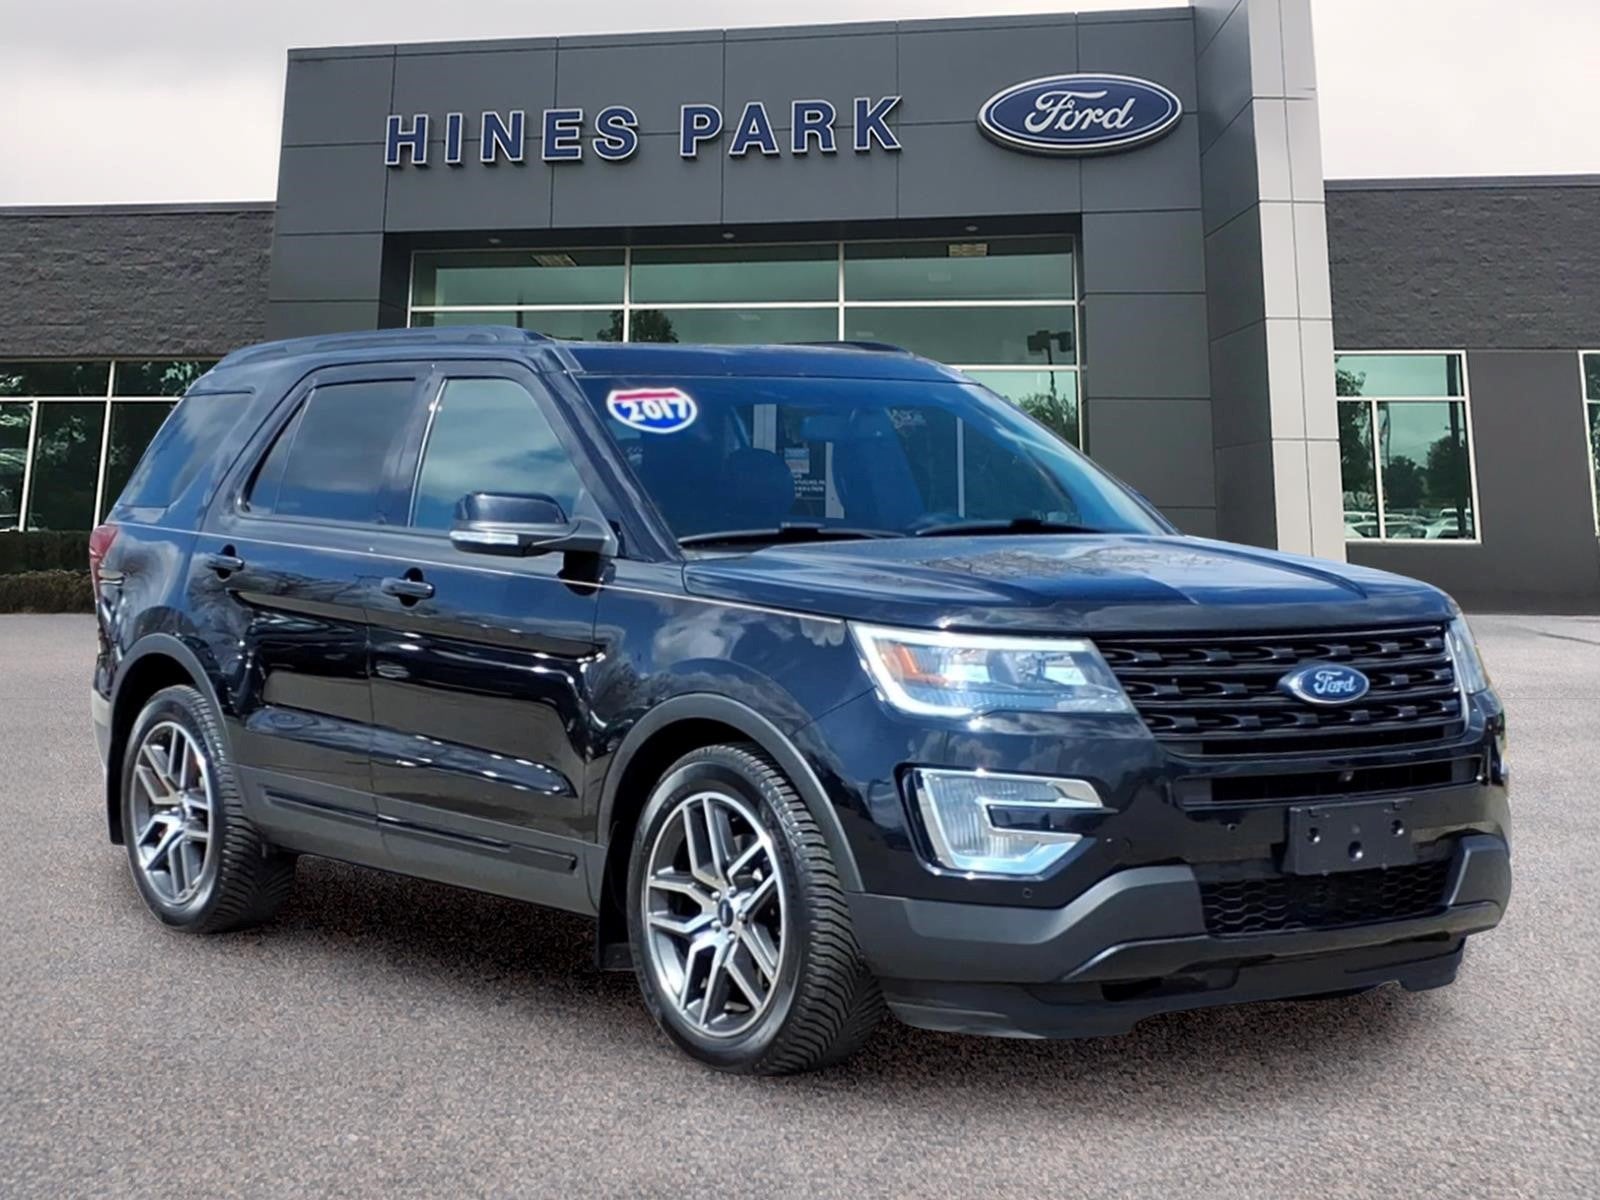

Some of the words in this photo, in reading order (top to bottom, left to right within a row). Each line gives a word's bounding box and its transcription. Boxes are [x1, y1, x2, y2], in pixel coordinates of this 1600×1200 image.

[1024, 90, 1136, 133] Ford
[384, 105, 639, 166] HINES
[679, 96, 903, 158] PARK
[620, 399, 687, 422] 2017
[1313, 670, 1357, 694] Ford
